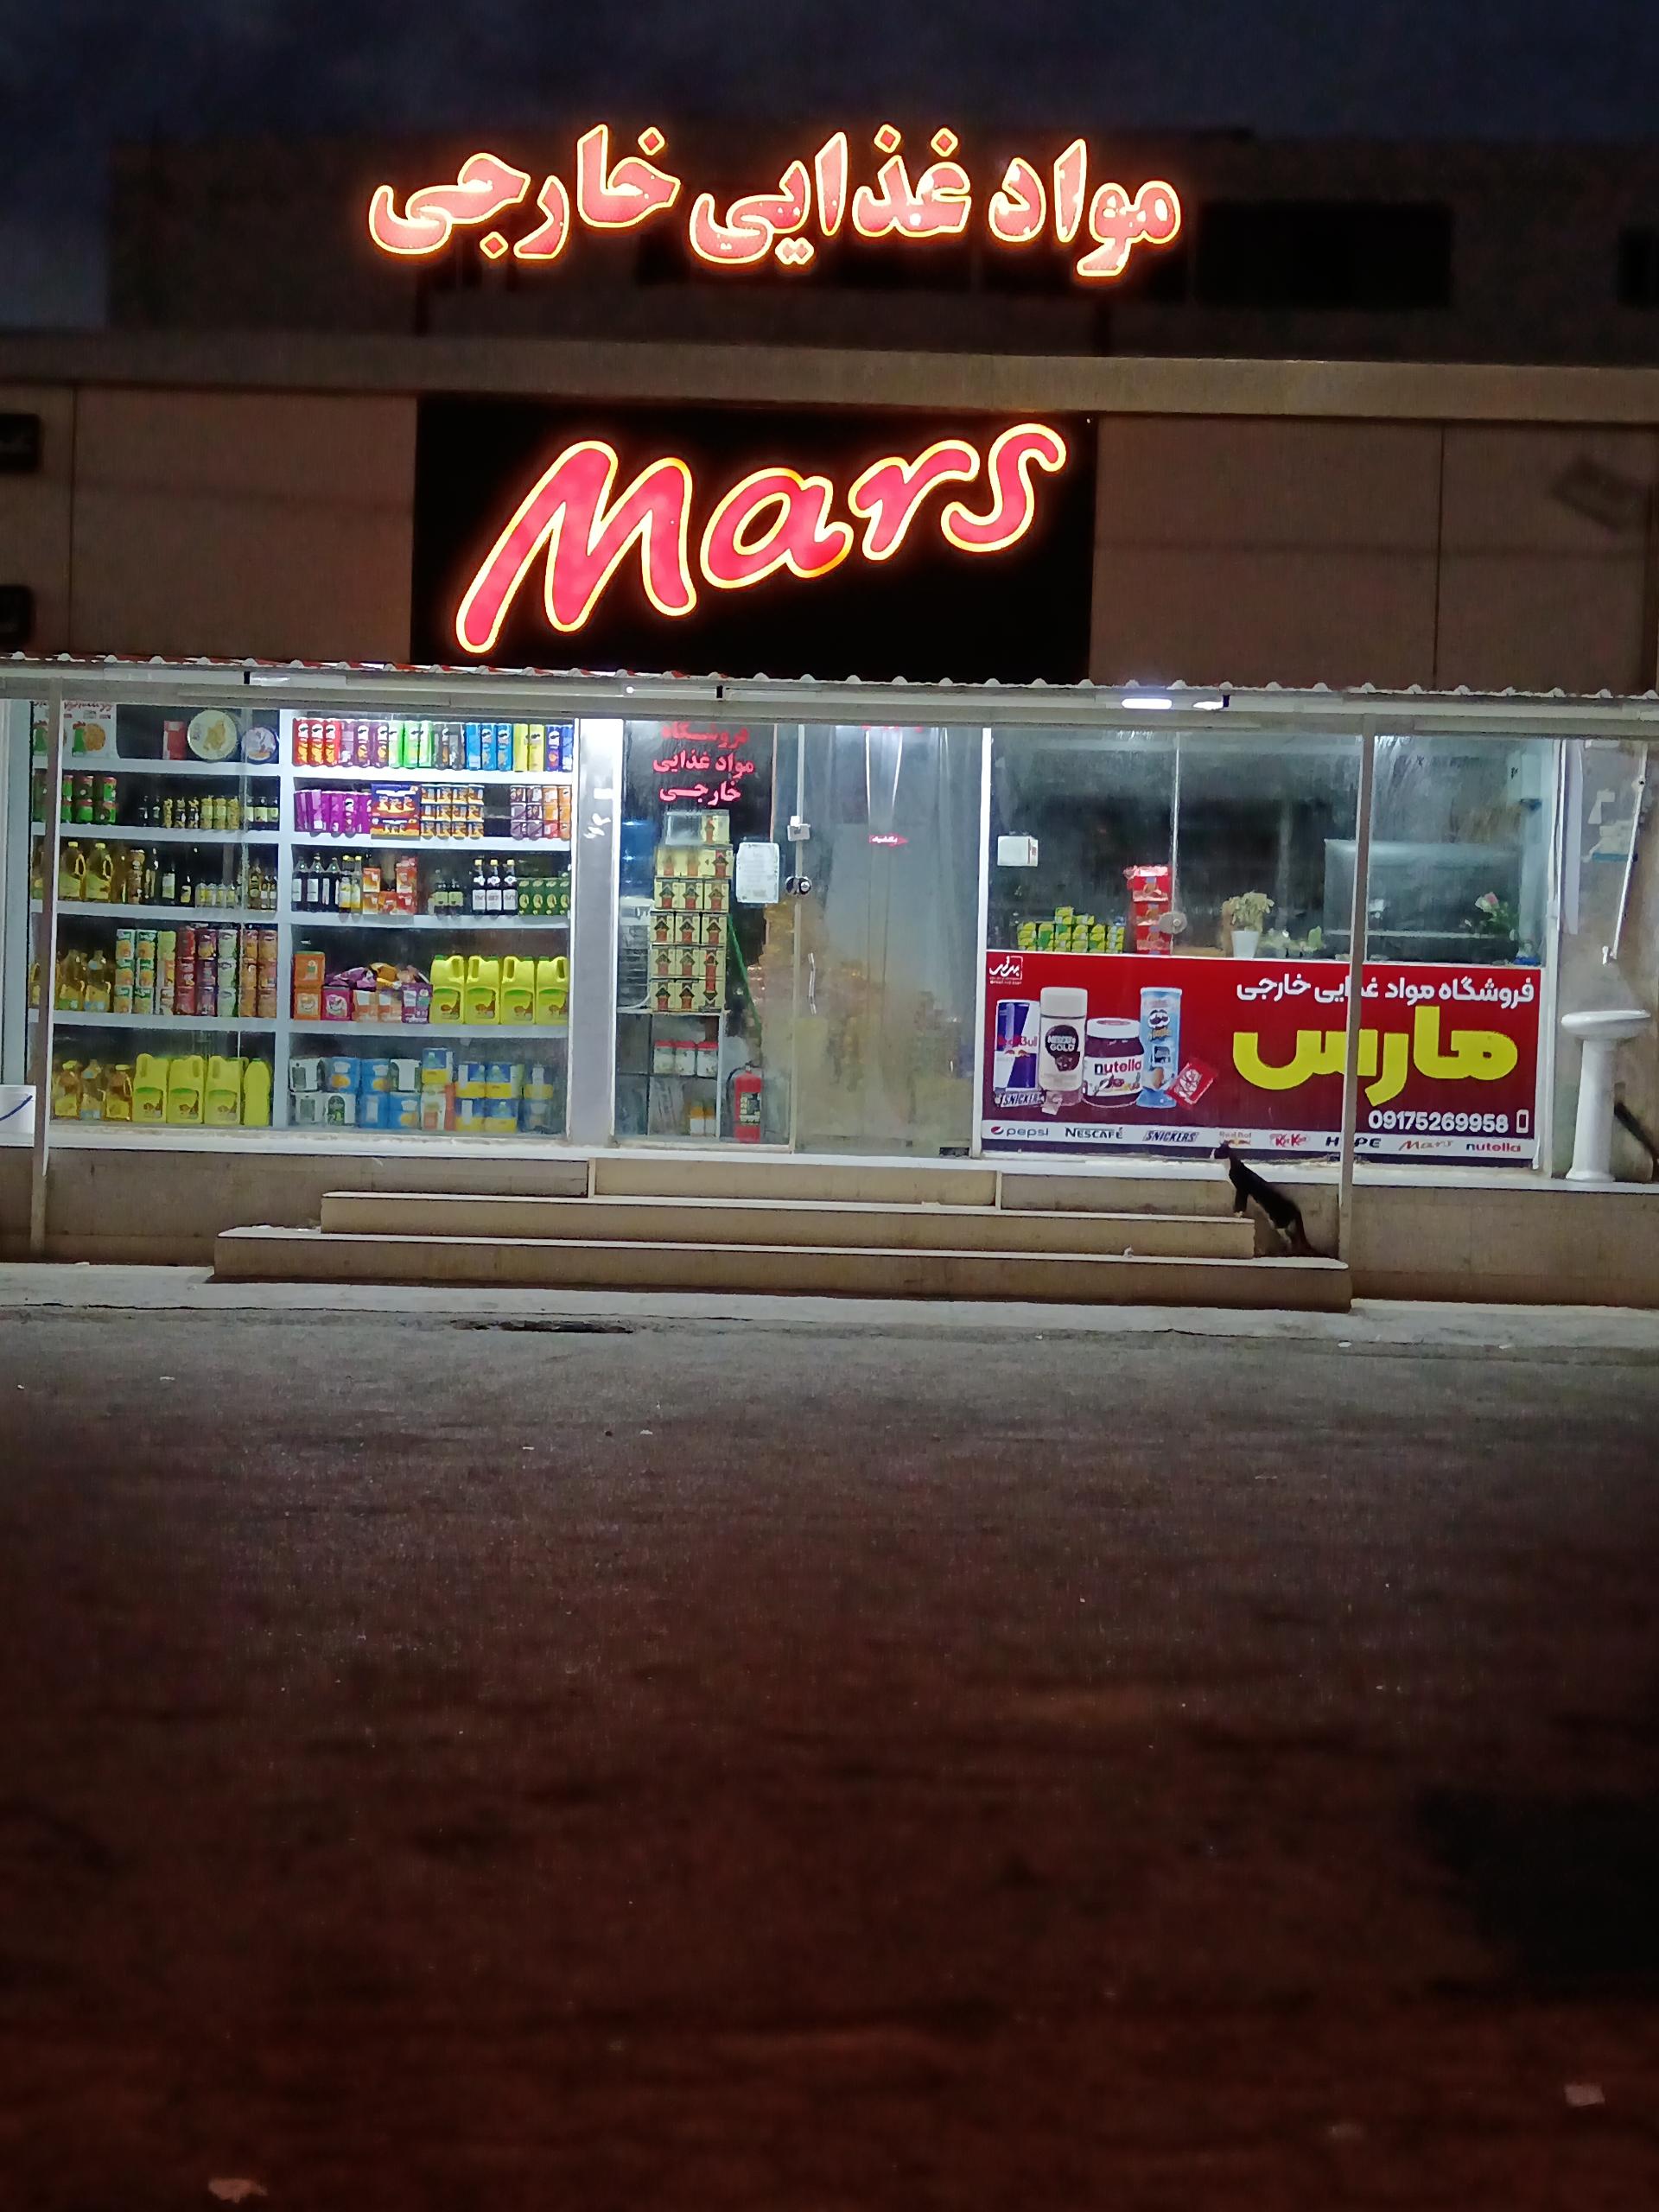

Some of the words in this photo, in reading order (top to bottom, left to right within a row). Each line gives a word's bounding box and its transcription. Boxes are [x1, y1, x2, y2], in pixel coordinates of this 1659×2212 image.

[369, 124, 681, 261] خارجی
[689, 124, 971, 265] غذایی
[988, 138, 1182, 277] مواد
[455, 423, 1066, 654] Mars
[652, 749, 712, 772] غذایی
[715, 753, 755, 780] مواد
[658, 779, 741, 805] خارجی
[1236, 973, 1312, 1002] خارجی
[1384, 976, 1435, 1006] مواد
[1438, 976, 1535, 1009] فروشگاه
[1094, 1058, 1142, 1076] nutella
[1232, 1005, 1518, 1108] مارس
[1006, 1127, 1049, 1139] pepsi
[1368, 1109, 1509, 1134] 09175269958
[1325, 1136, 1382, 1149] HPE
[1465, 1142, 1522, 1154] nutella
